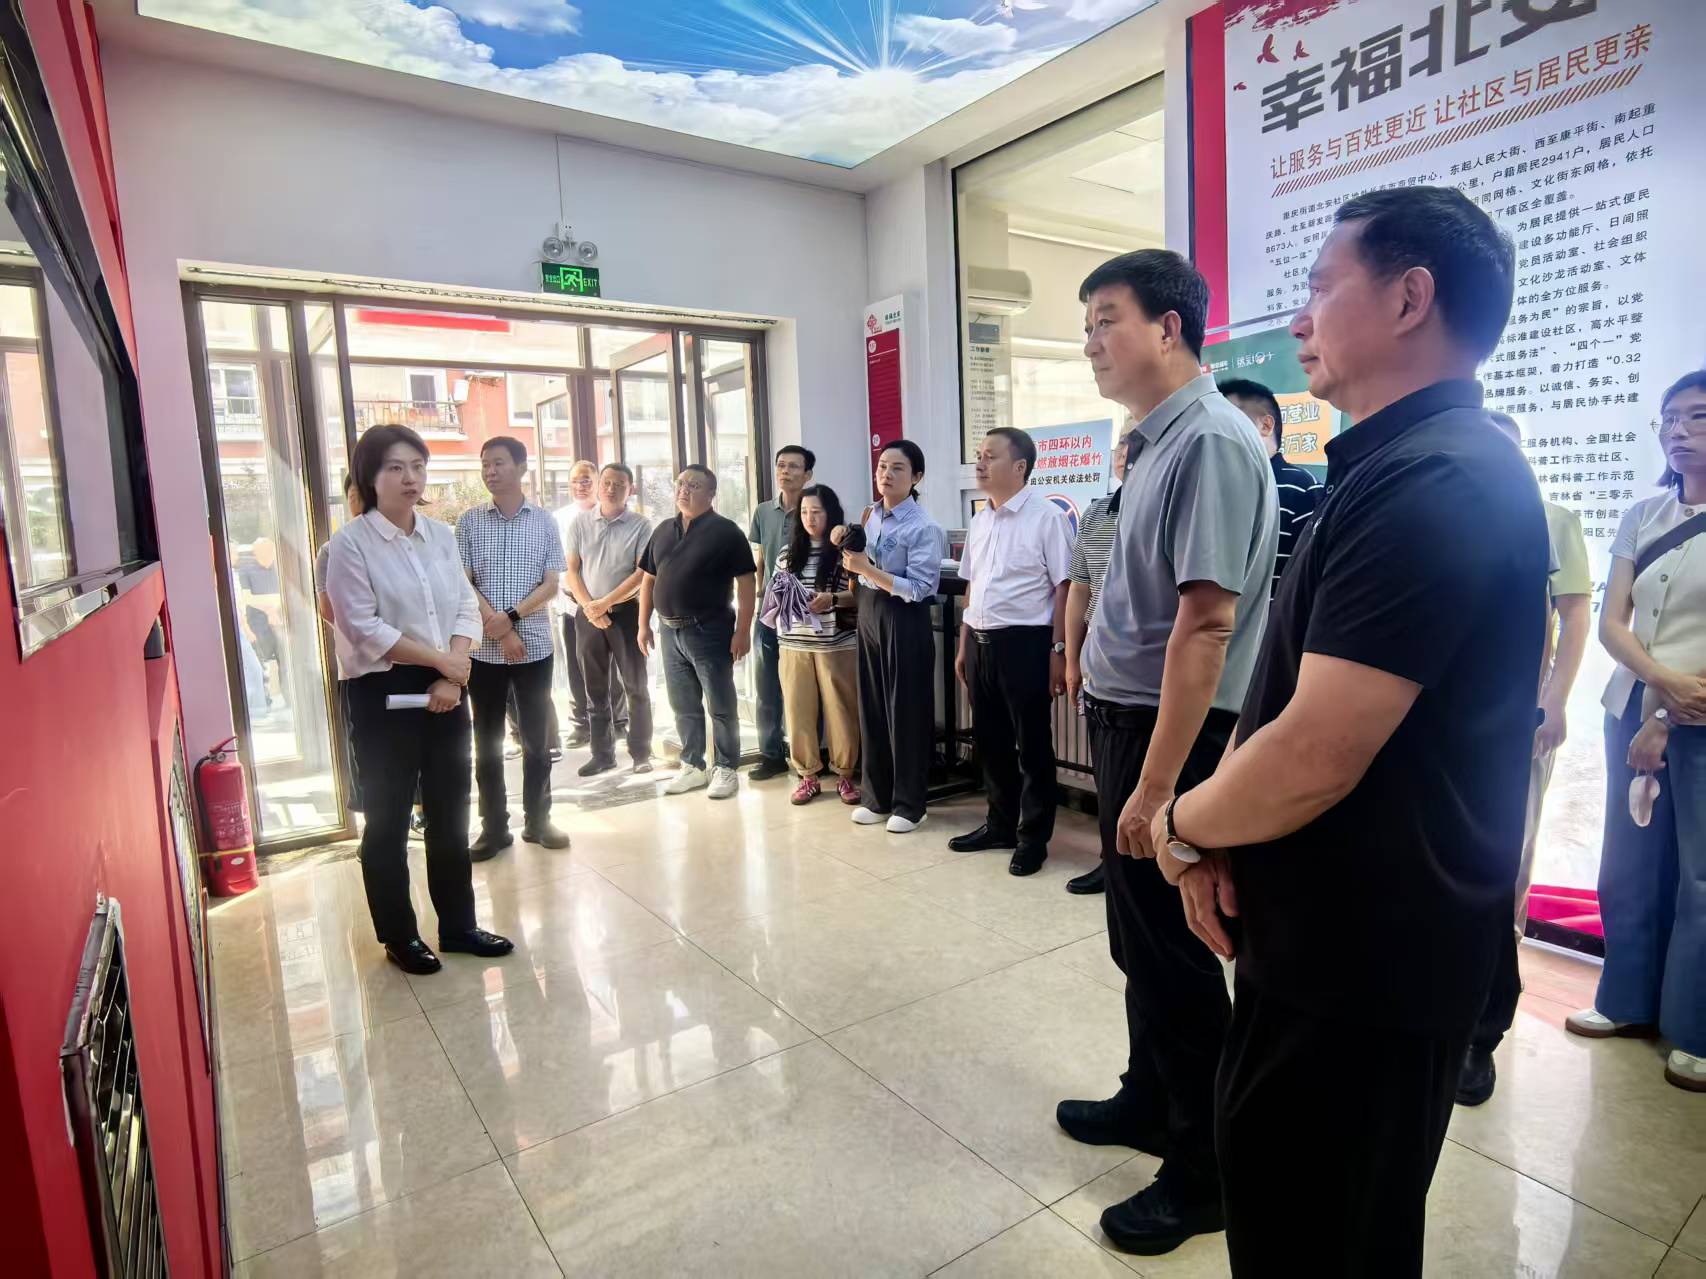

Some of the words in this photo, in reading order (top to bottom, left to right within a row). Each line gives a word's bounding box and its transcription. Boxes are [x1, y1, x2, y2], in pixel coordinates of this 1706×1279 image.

[1270, 105, 1427, 180] 让服务与百姓更近
[1433, 23, 1653, 126] 让社区与居民更亲
[1488, 191, 1576, 220] 了辖区全覆盖。
[1517, 188, 1650, 233] 为居民提供一站式便民
[1518, 209, 1649, 251] 建设多功能厅、日间照
[1518, 230, 1648, 270] 党员活动室、社会组织
[583, 278, 597, 287] EXIT
[1518, 251, 1647, 288] 文化沙龙活动室、文体
[1489, 332, 1642, 364] 式服务法”、“四个一”党
[1034, 435, 1092, 452] 市四环以内
